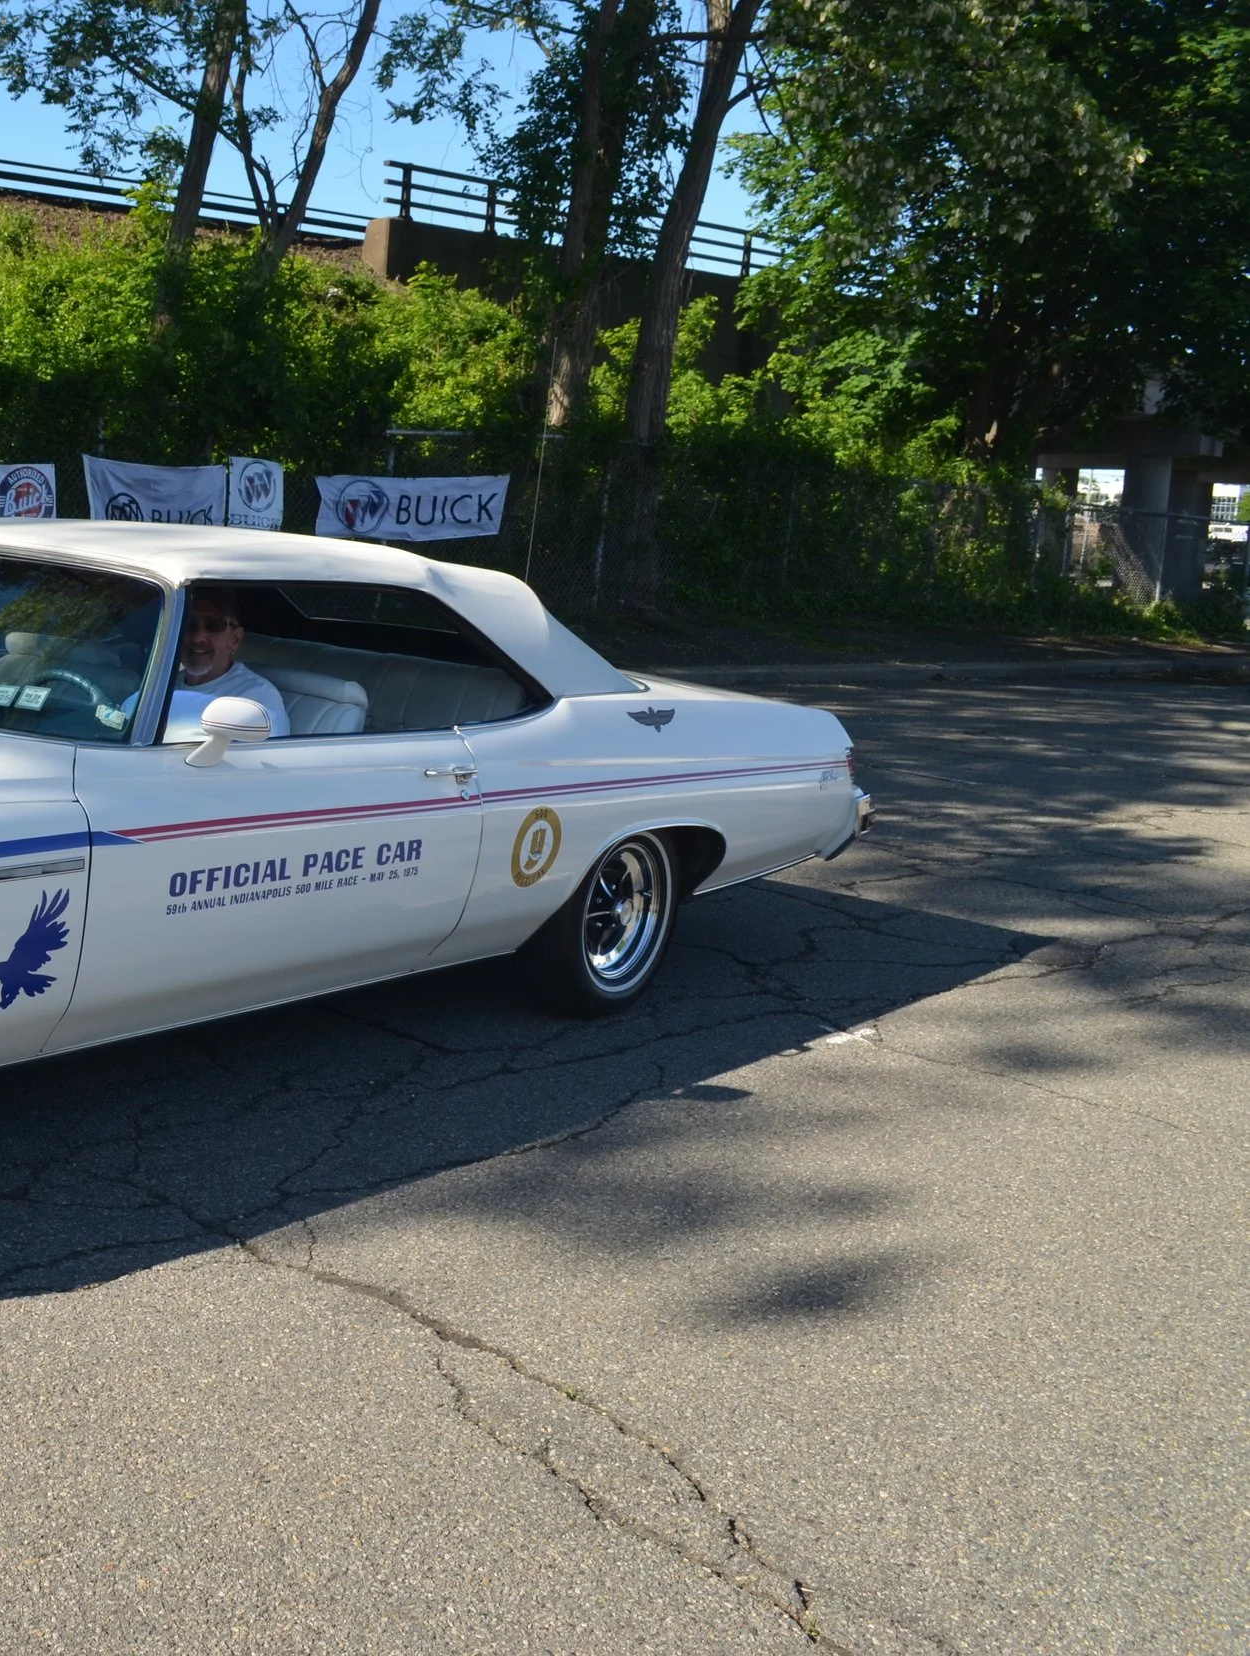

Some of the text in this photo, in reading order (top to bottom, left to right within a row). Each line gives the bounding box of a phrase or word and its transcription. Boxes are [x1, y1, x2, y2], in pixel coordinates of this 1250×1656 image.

[3, 483, 50, 517] Buick
[396, 492, 499, 526] BUICK
[168, 838, 423, 898] OFFICIAL PACE CAR
[165, 903, 188, 916] 59th
[190, 896, 227, 912] ANNUAL
[229, 885, 292, 906] INDIANAPOLIS
[295, 883, 311, 895] 500
[313, 879, 334, 892] MILE
[336, 875, 359, 888] RACE
[369, 871, 386, 883] MAY
[403, 866, 419, 877] 1975
